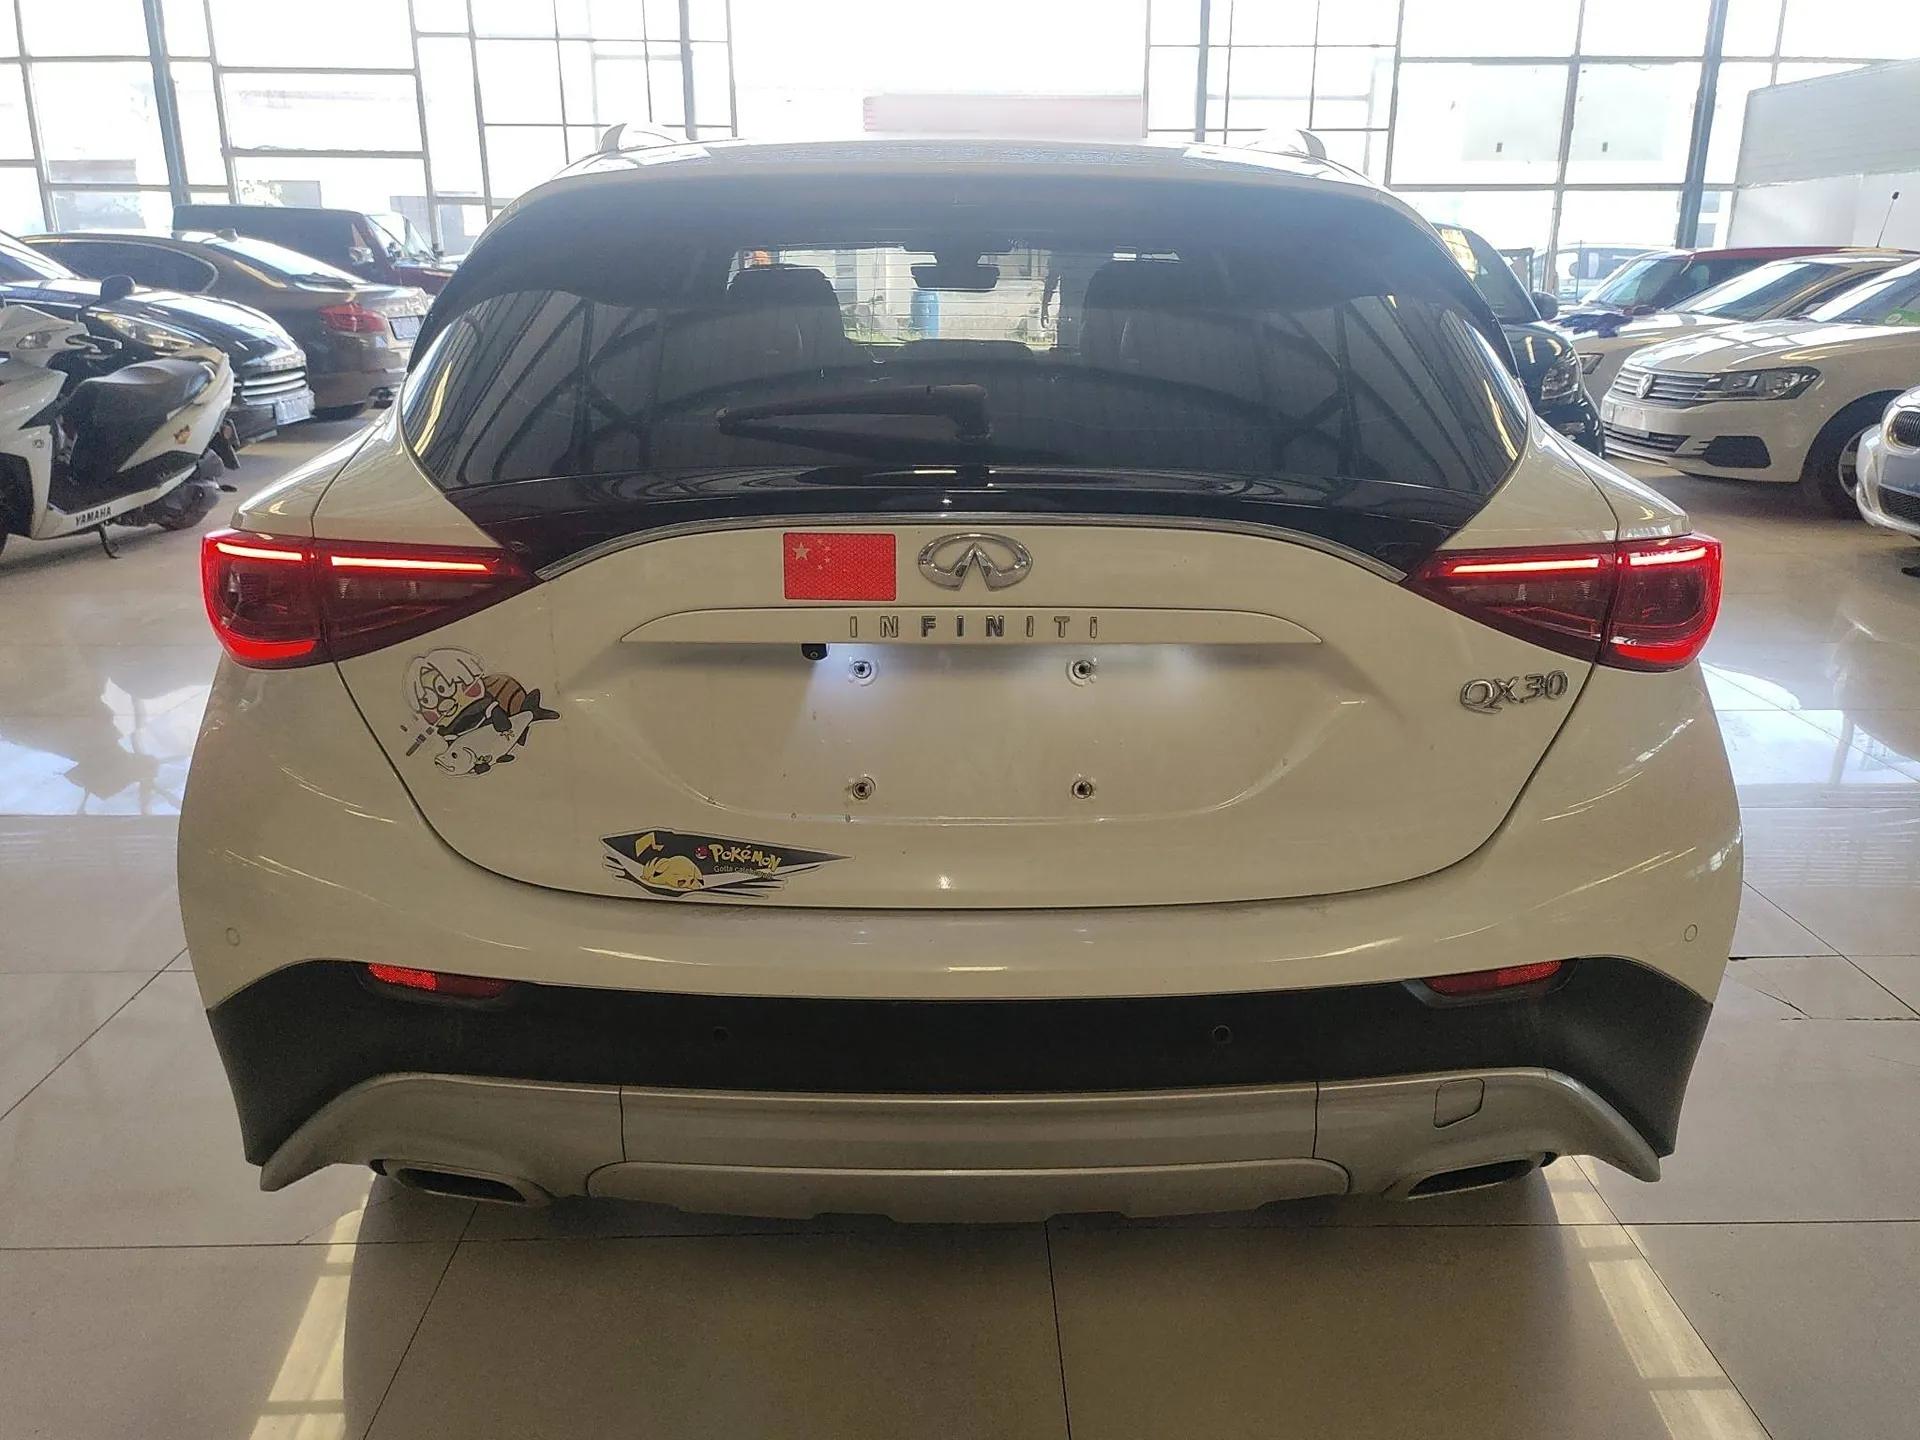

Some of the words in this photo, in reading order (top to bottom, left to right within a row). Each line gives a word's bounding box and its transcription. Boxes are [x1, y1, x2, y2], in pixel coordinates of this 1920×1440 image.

[75, 507, 112, 526] YAMAHA
[850, 615, 1099, 639] INFINITI
[1459, 669, 1569, 714] QX30
